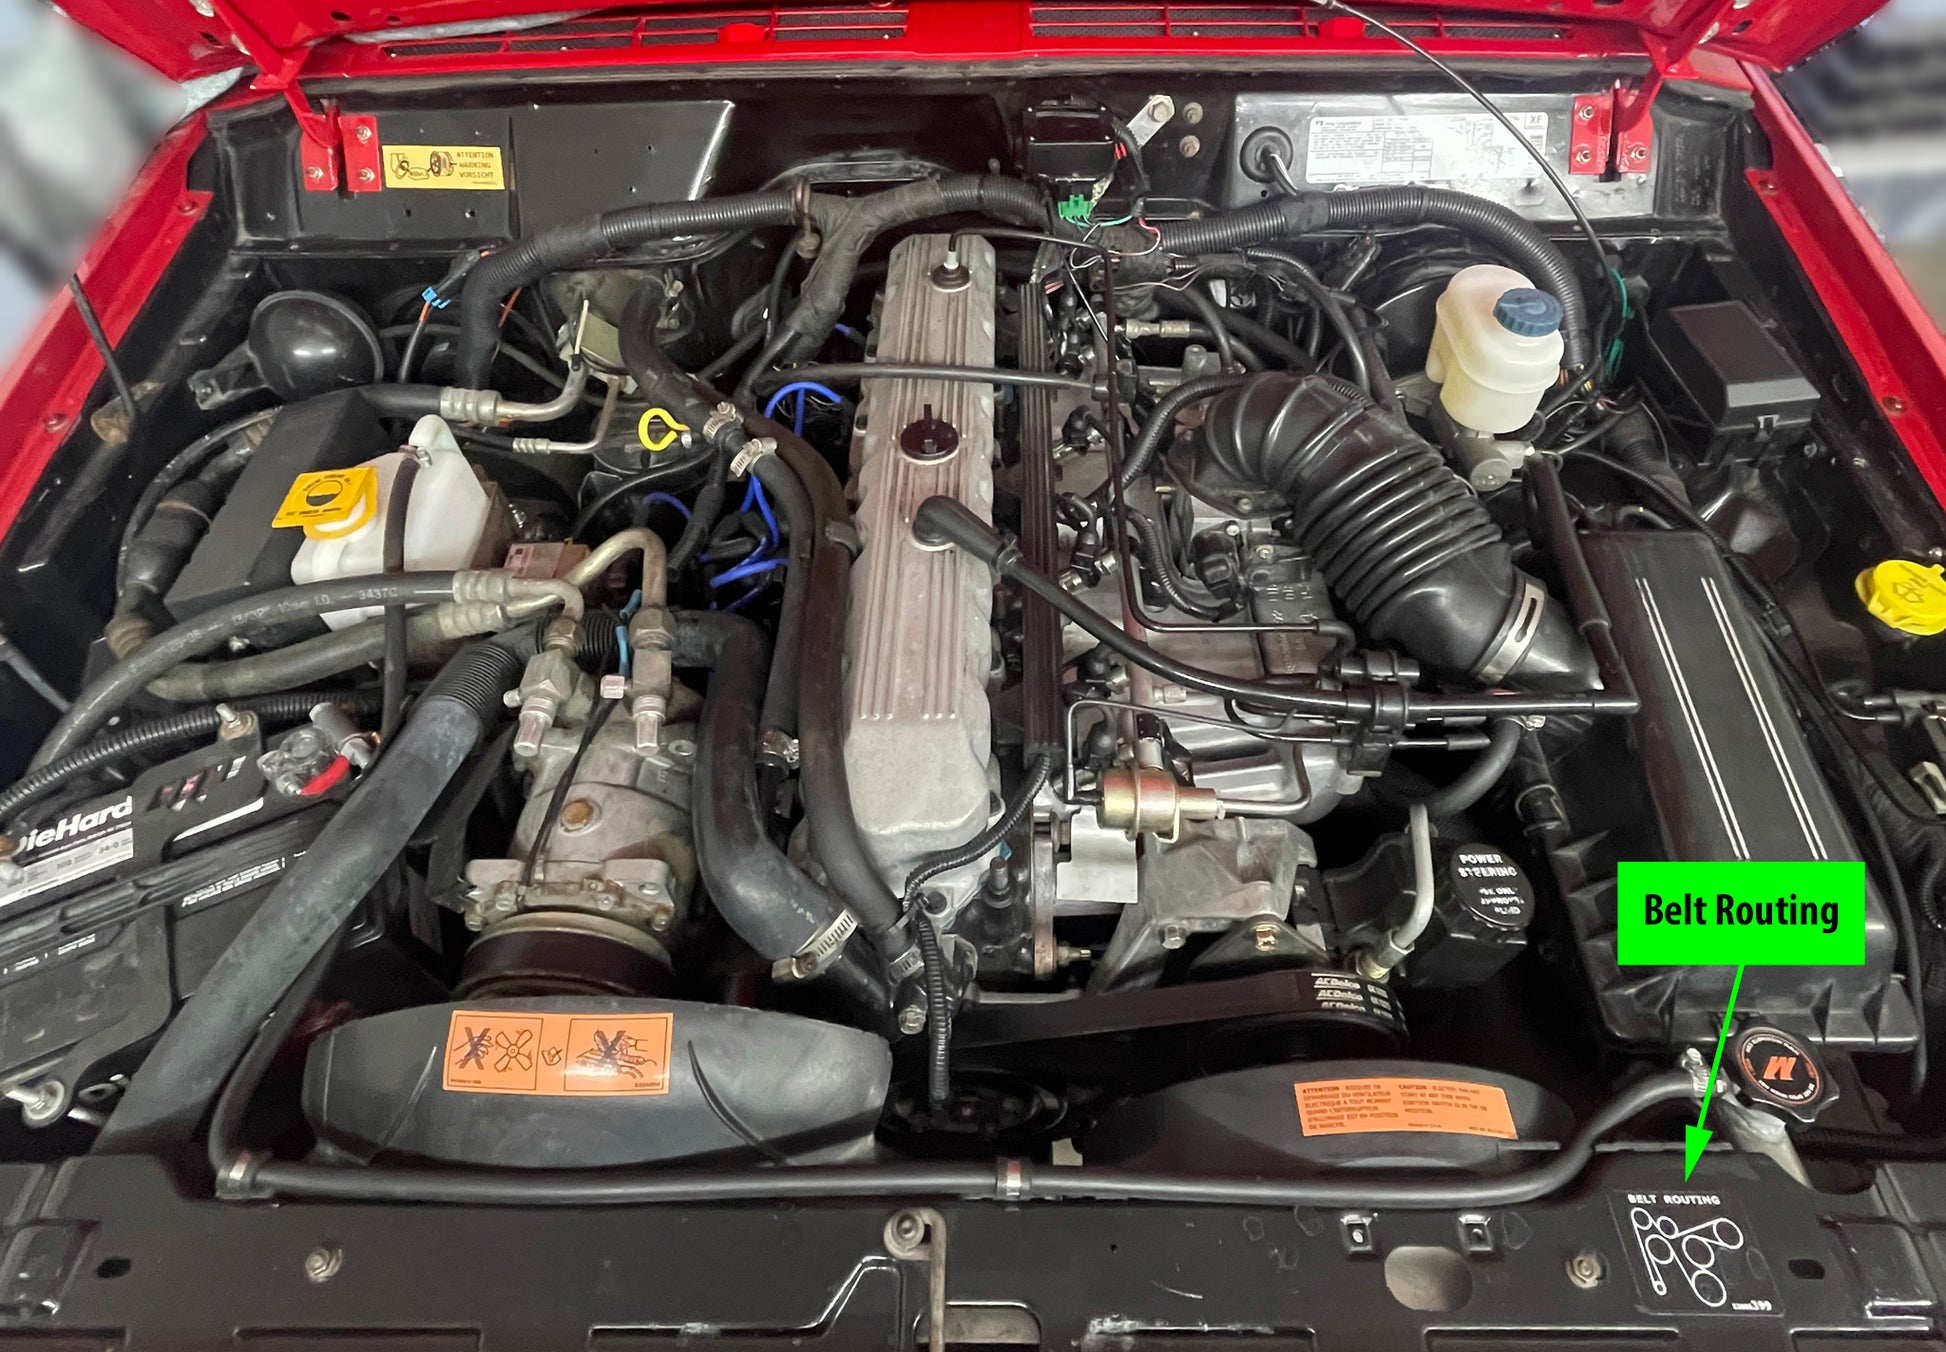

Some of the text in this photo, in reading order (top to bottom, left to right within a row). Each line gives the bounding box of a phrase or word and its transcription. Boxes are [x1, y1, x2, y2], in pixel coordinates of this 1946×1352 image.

[1530, 115, 1542, 124] XF
[1459, 854, 1503, 864] POWER
[1458, 866, 1517, 877] STEERING
[1315, 977, 1361, 989] ACDelco
[1317, 989, 1364, 1001] ACDelco
[1627, 1194, 1721, 1205] BELT ROUTING
